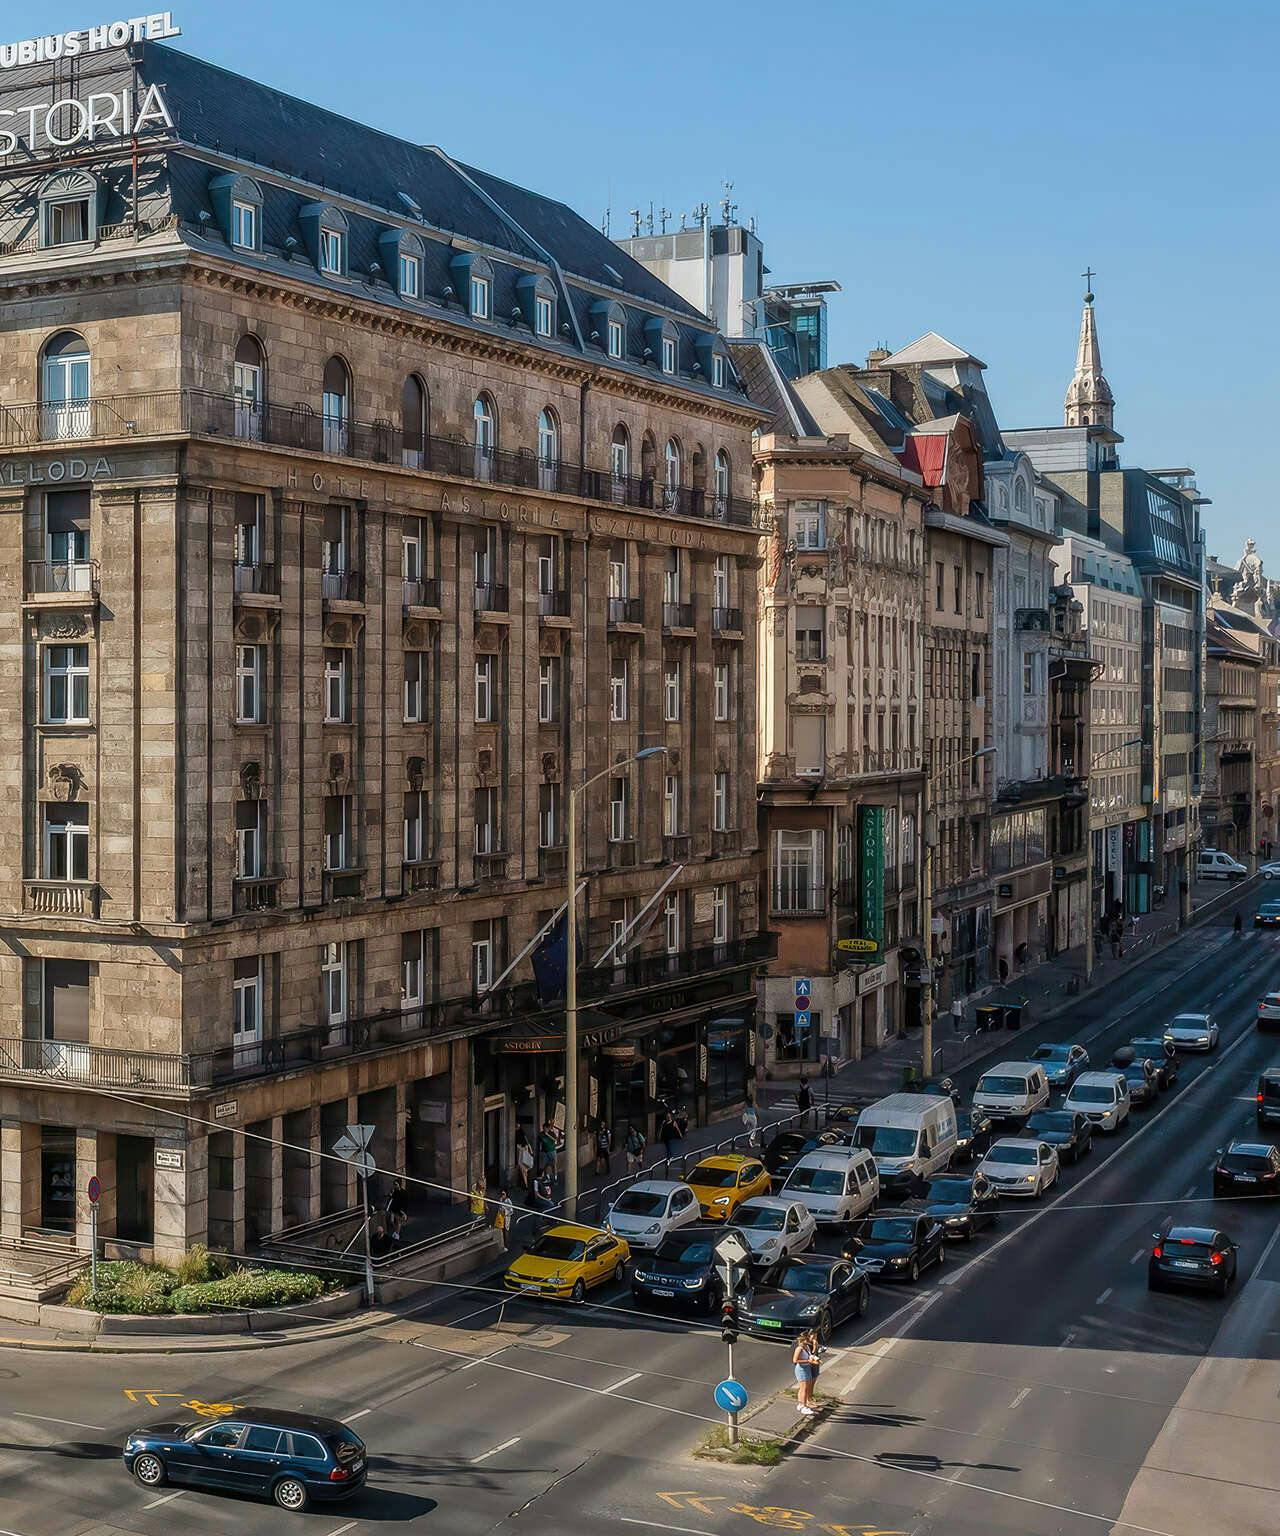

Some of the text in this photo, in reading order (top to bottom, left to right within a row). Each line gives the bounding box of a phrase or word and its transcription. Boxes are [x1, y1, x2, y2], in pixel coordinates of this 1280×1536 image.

[88, 11, 183, 51] HOTEL
[286, 467, 393, 502] HOTEL
[440, 489, 561, 527] ASTORIA
